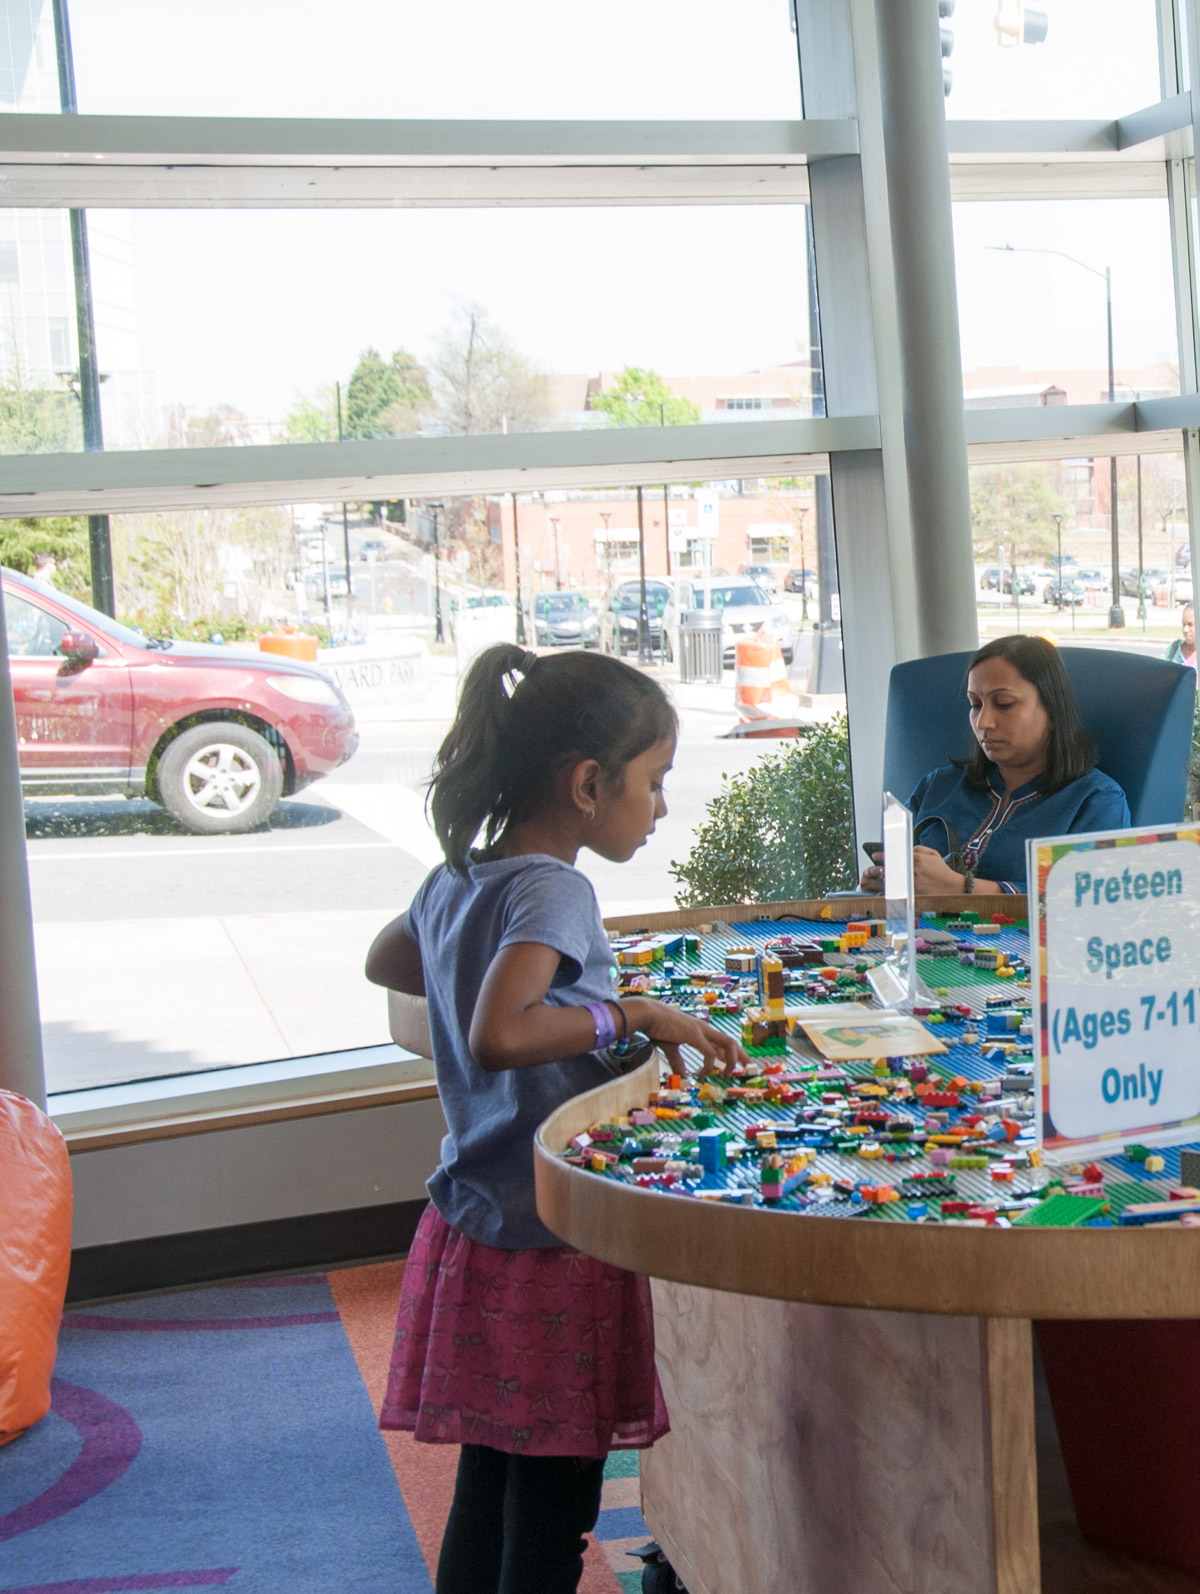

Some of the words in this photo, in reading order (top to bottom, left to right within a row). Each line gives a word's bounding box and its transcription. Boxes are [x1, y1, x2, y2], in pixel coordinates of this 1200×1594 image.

[1074, 867, 1182, 908] Preteen
[1086, 935, 1172, 979] Space
[1052, 1006, 1131, 1054] (Ages
[1101, 1062, 1163, 1106] Only
